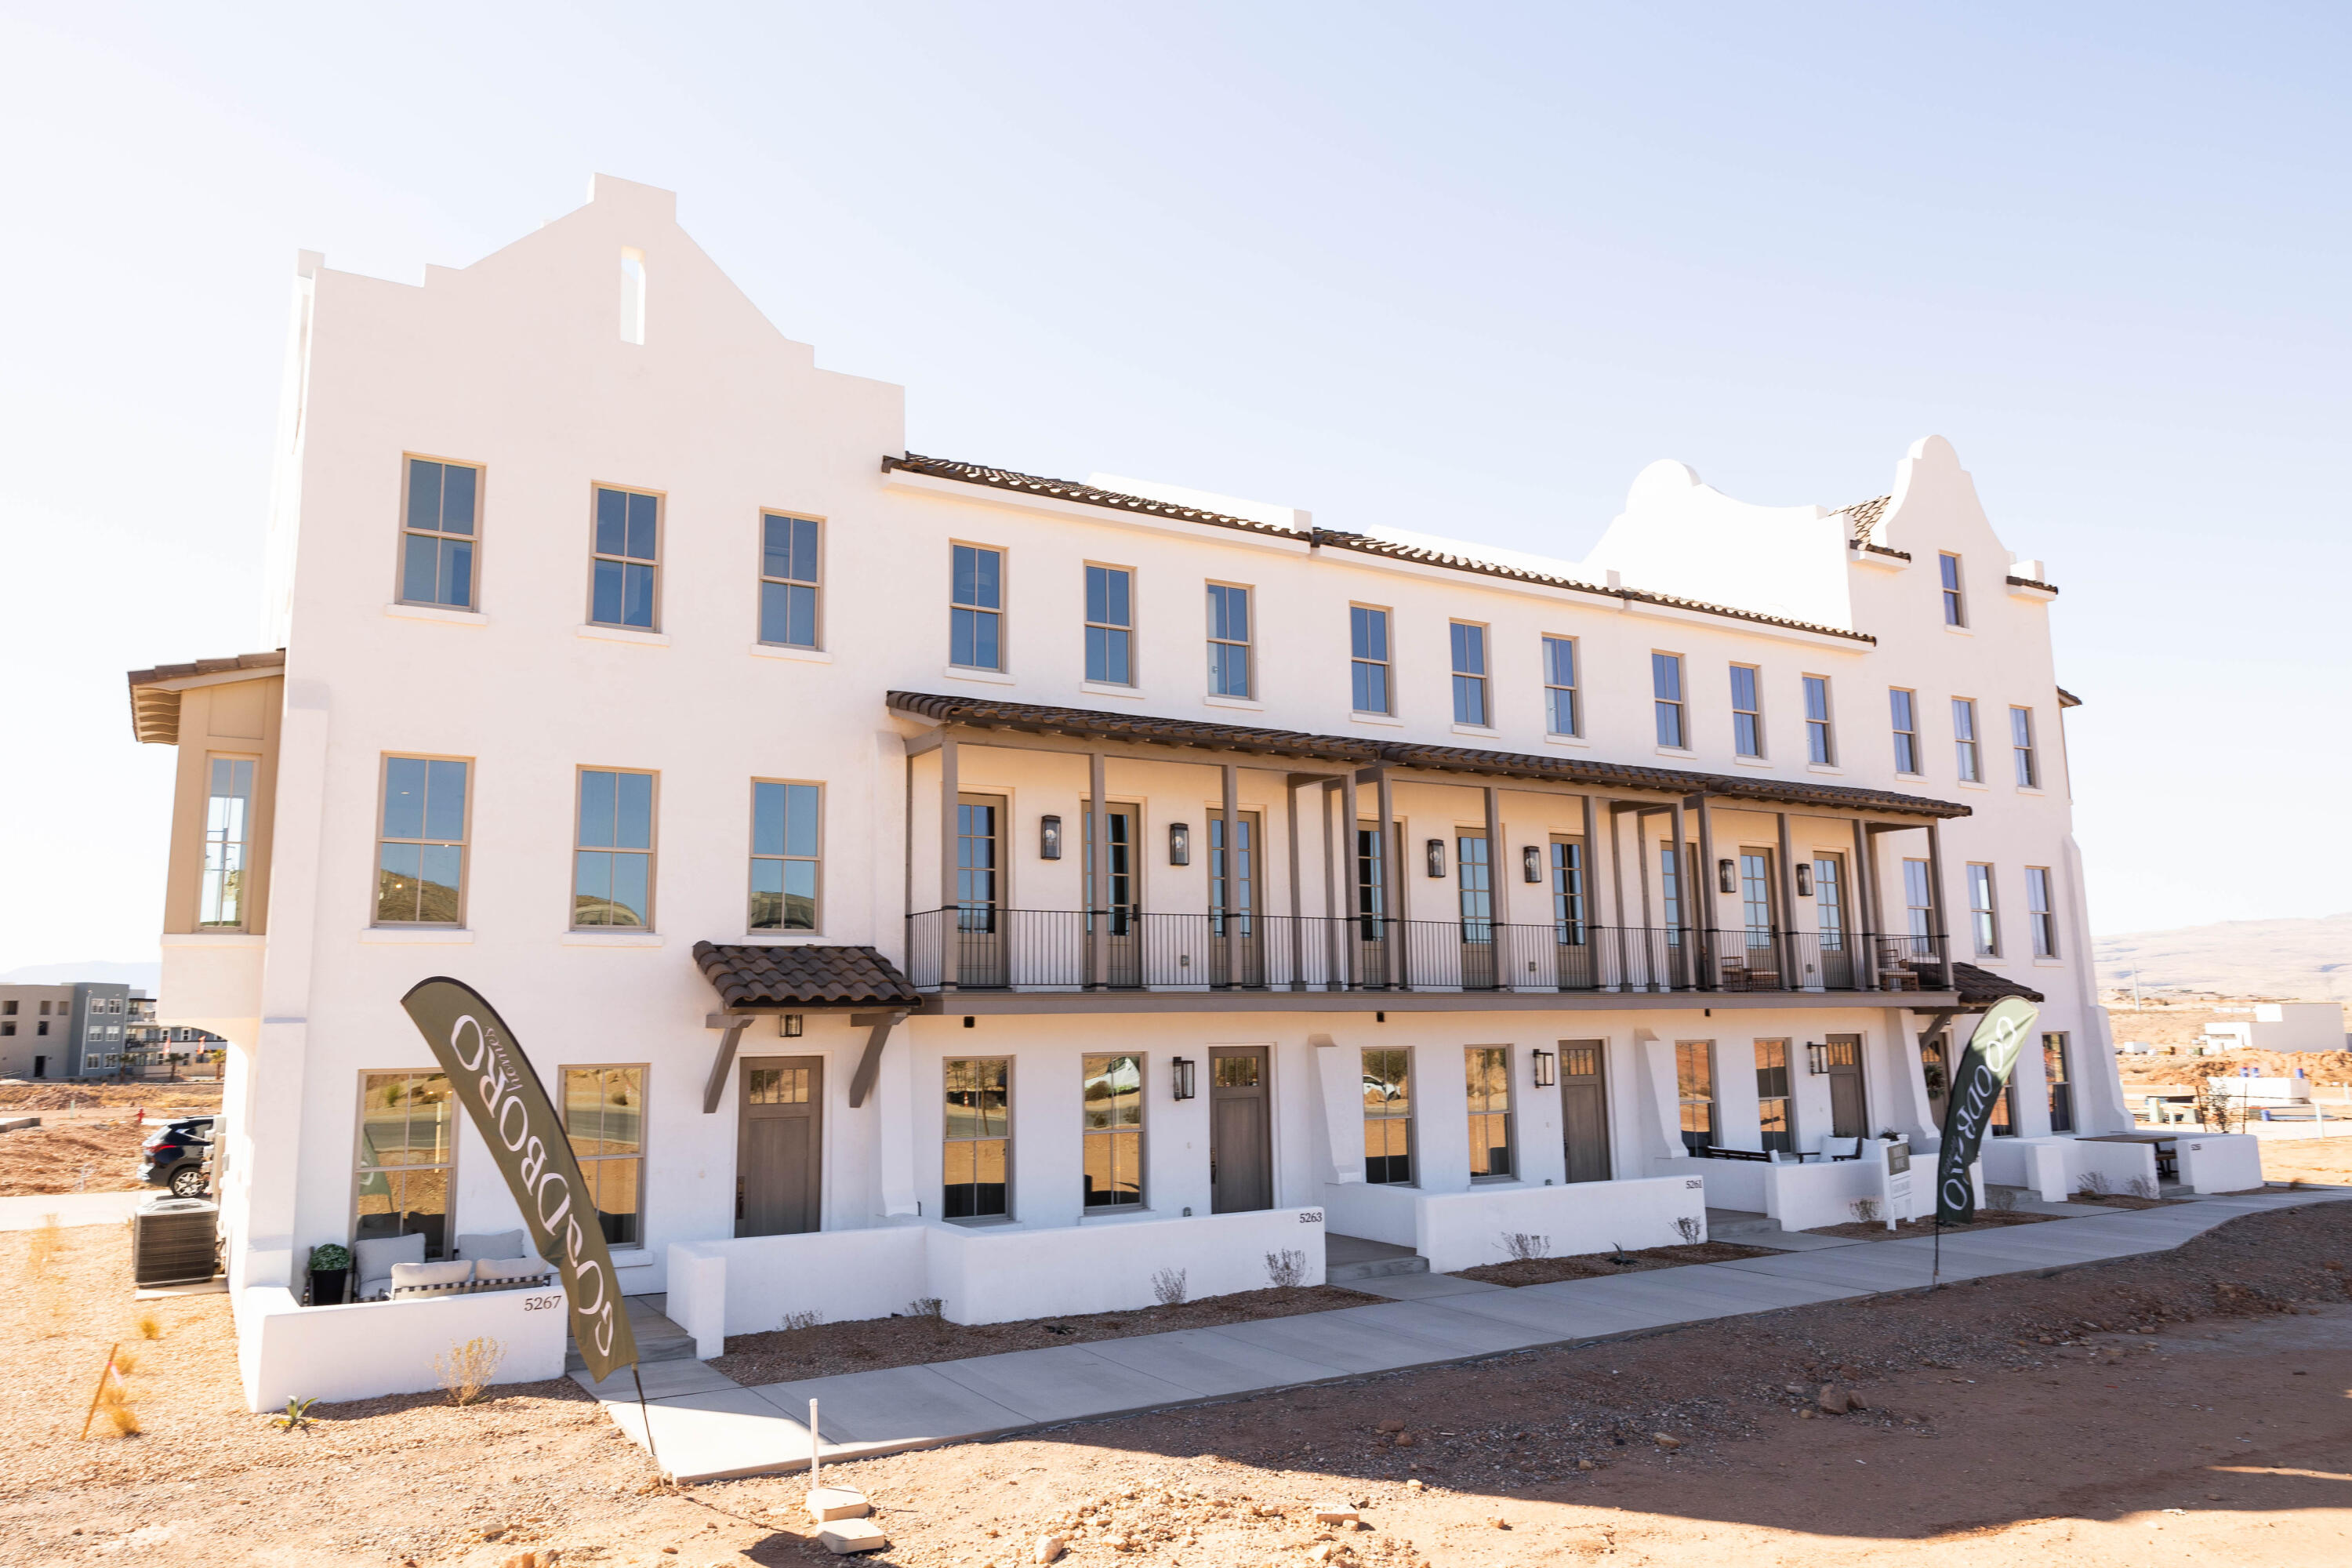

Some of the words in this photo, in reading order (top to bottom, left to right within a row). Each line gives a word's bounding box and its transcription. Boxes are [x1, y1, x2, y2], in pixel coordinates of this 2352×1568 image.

[485, 1025, 524, 1091] homes
[1299, 1212, 1323, 1223] 5263
[524, 1295, 562, 1311] 5267
